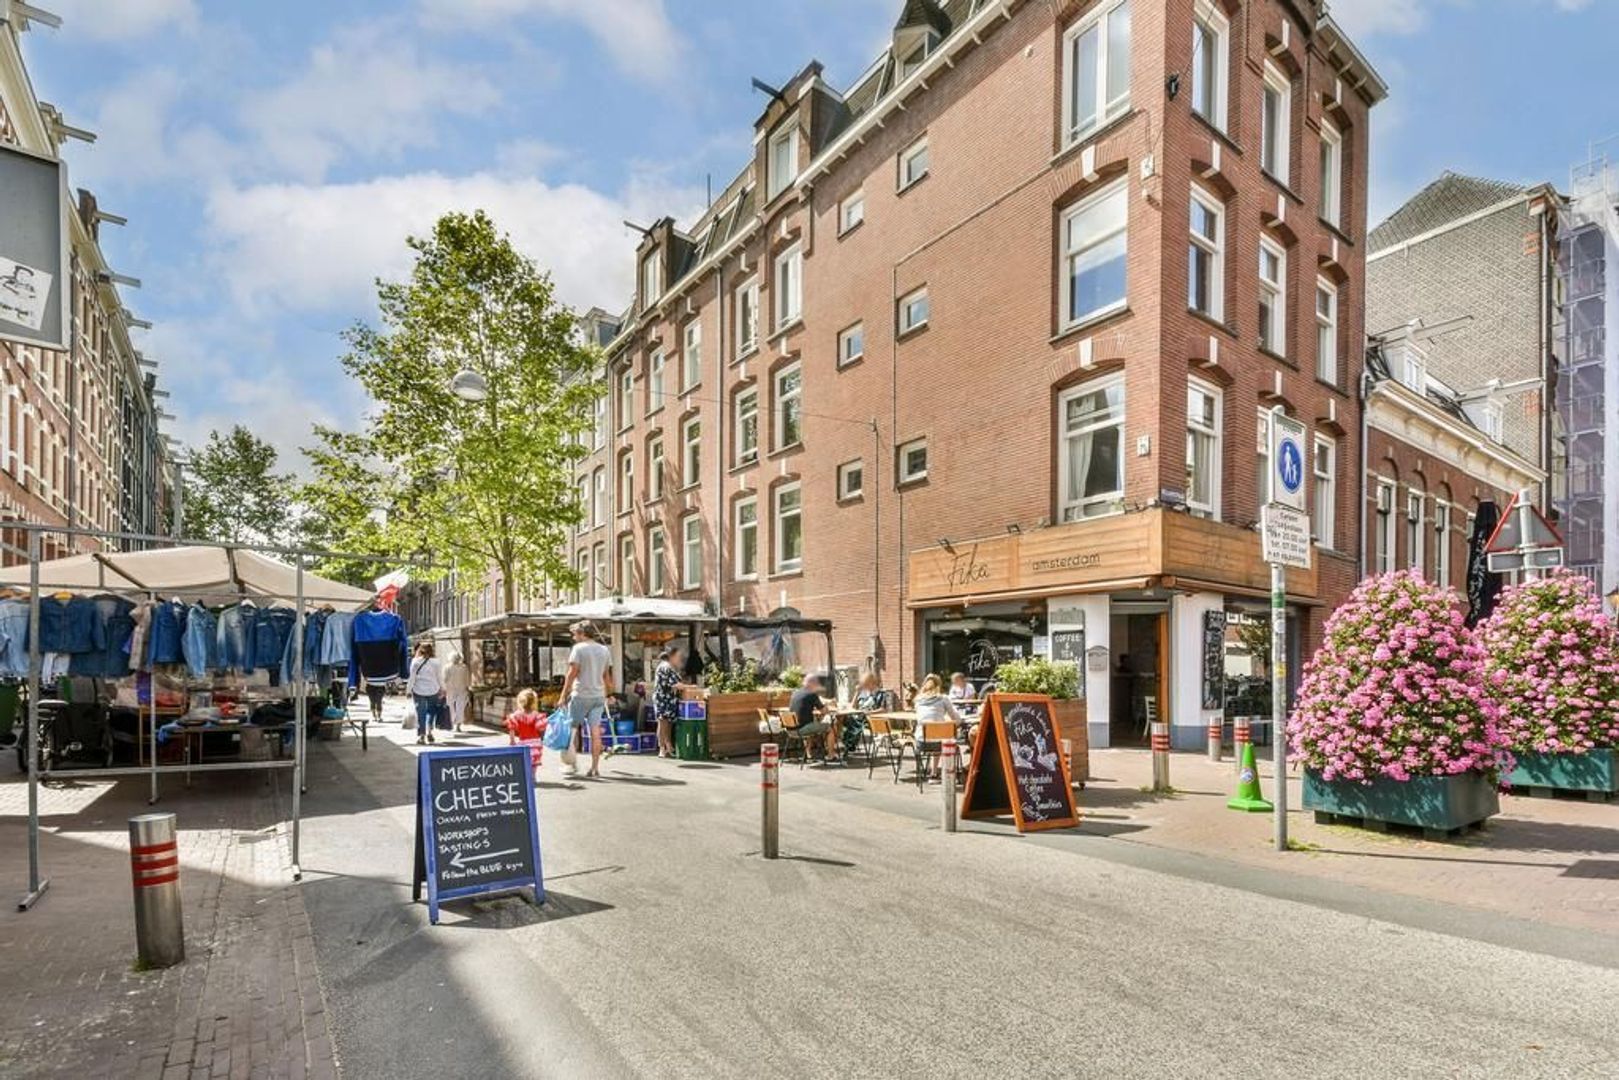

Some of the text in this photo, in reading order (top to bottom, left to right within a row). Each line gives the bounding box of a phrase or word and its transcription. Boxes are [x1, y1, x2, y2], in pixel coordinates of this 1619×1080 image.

[947, 543, 1101, 592] Fika amsterdam
[1055, 633, 1082, 642] COFFEE
[968, 650, 991, 674] Fika
[441, 763, 513, 782] MEXICAN
[435, 782, 522, 812] CHEESE
[438, 838, 491, 854] TASTINGS
